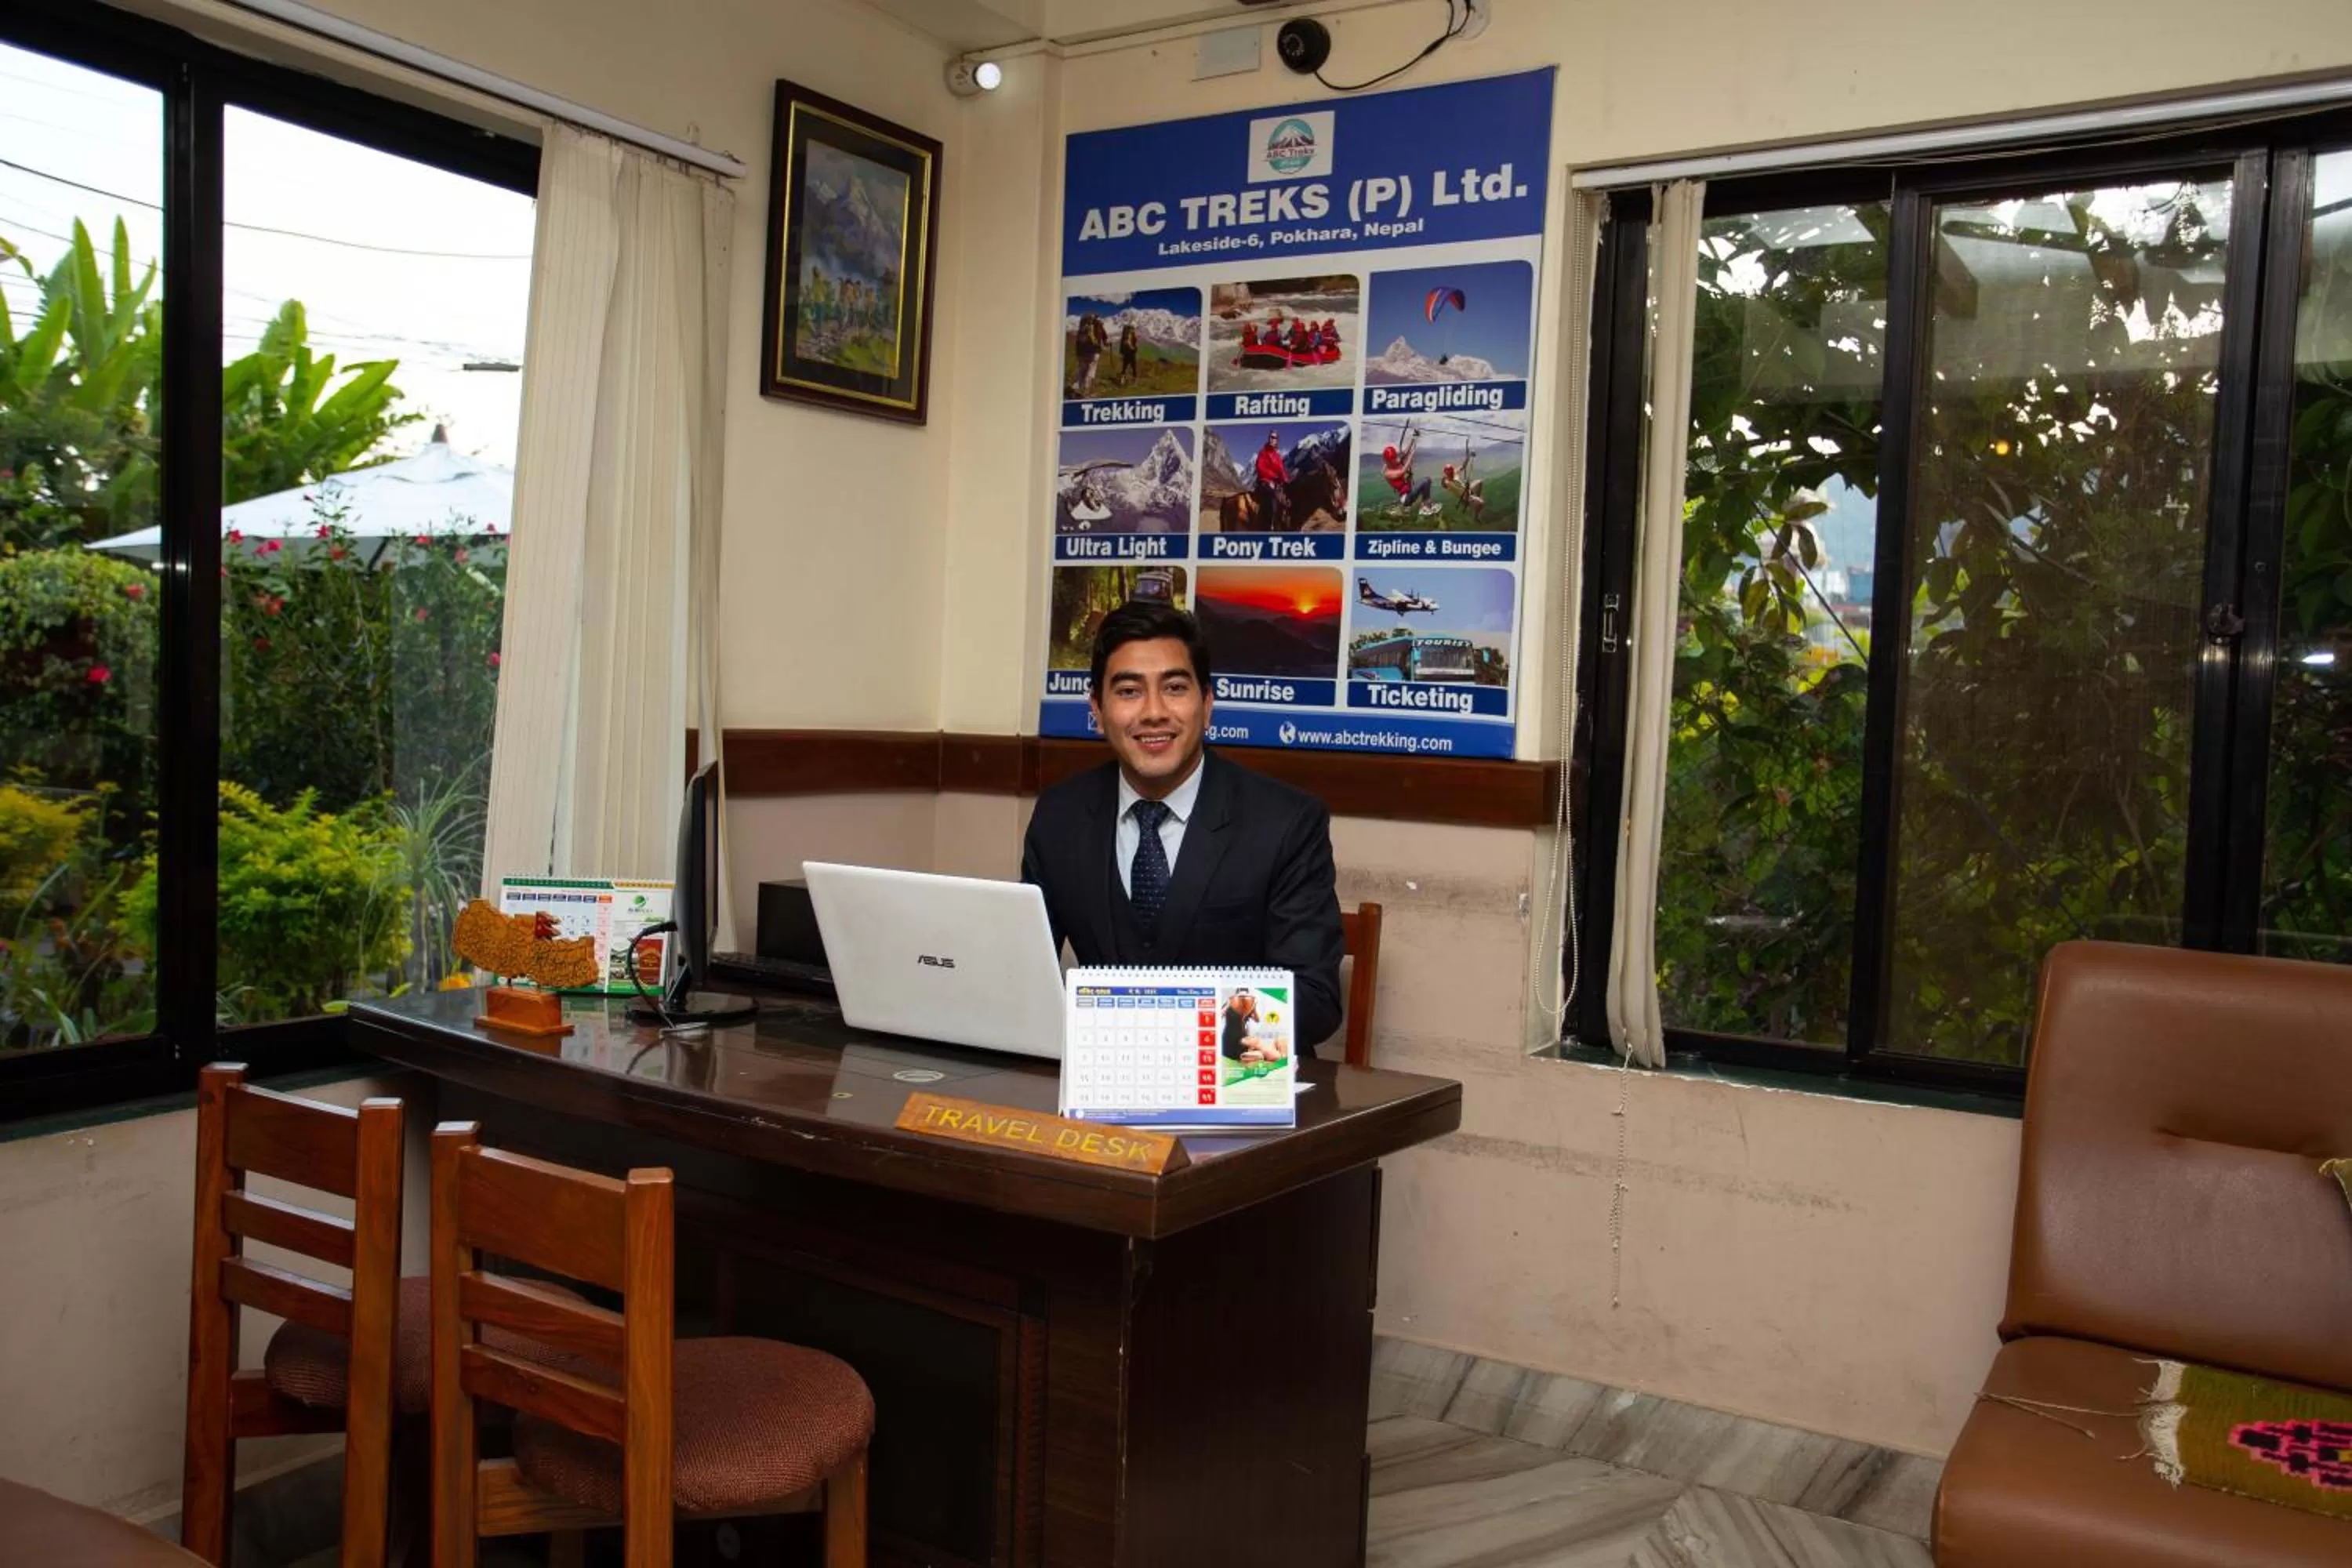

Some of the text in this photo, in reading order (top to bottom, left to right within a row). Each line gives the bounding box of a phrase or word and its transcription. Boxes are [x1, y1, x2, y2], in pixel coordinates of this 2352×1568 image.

[1079, 163, 1529, 241] ABC TREKS (P) Ltd.
[1158, 217, 1425, 256] Lakeside-6, Pokhara, Nepal
[1235, 394, 1311, 417] Rafting
[1372, 385, 1504, 413] Paragliding
[1081, 401, 1165, 423] Trekking
[1066, 535, 1167, 560] Ultra Light
[1213, 537, 1316, 559] Pony Trek
[1367, 539, 1501, 561] Zipline & Bungee
[1216, 677, 1295, 701] Sunrise
[1367, 684, 1473, 714] Ticketing
[1298, 728, 1453, 752] www.abctrekking.com
[917, 955, 955, 969] ASUS
[924, 1105, 1152, 1162] TRAVEL DESK
